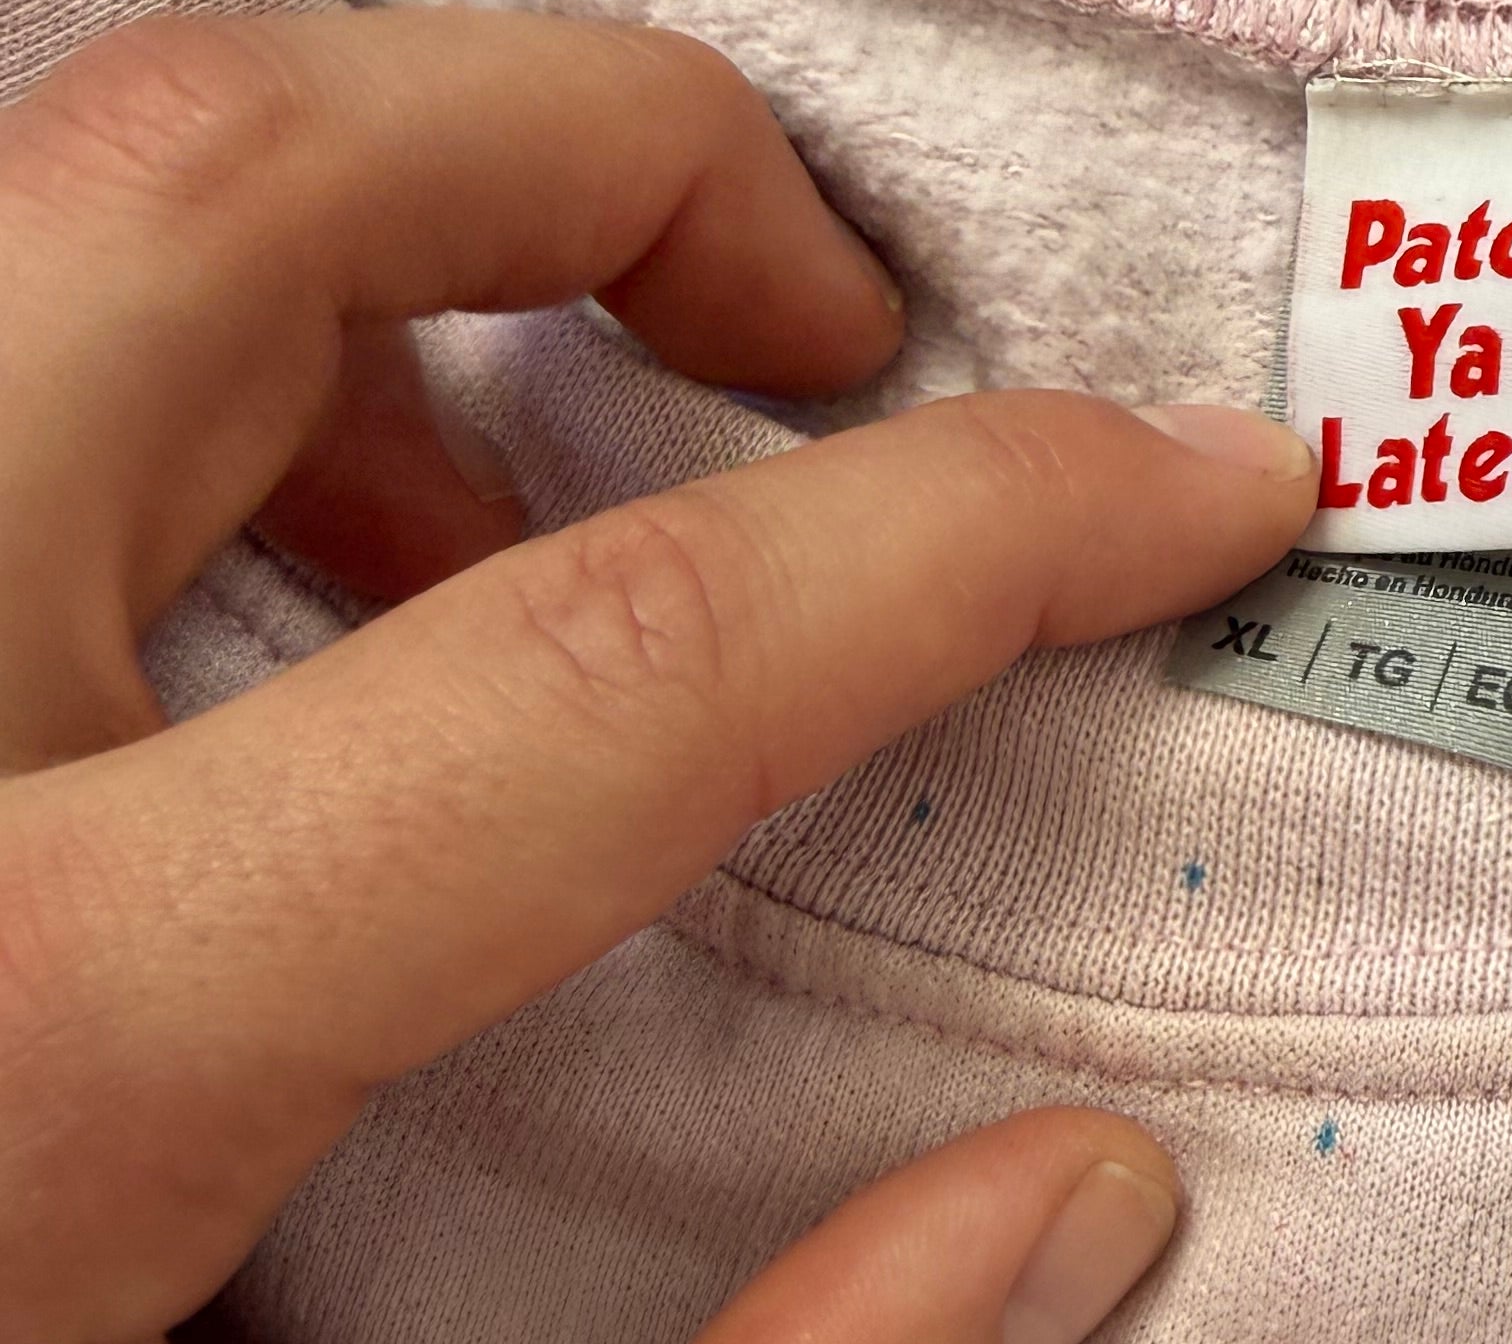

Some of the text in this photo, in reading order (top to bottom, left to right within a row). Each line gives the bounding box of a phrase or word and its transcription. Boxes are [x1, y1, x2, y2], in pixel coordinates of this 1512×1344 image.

[1397, 302, 1504, 400] Ya
[1286, 558, 1369, 589] Hecho
[1375, 575, 1406, 594] en
[1211, 616, 1278, 662] XL
[1346, 641, 1417, 687] TG
